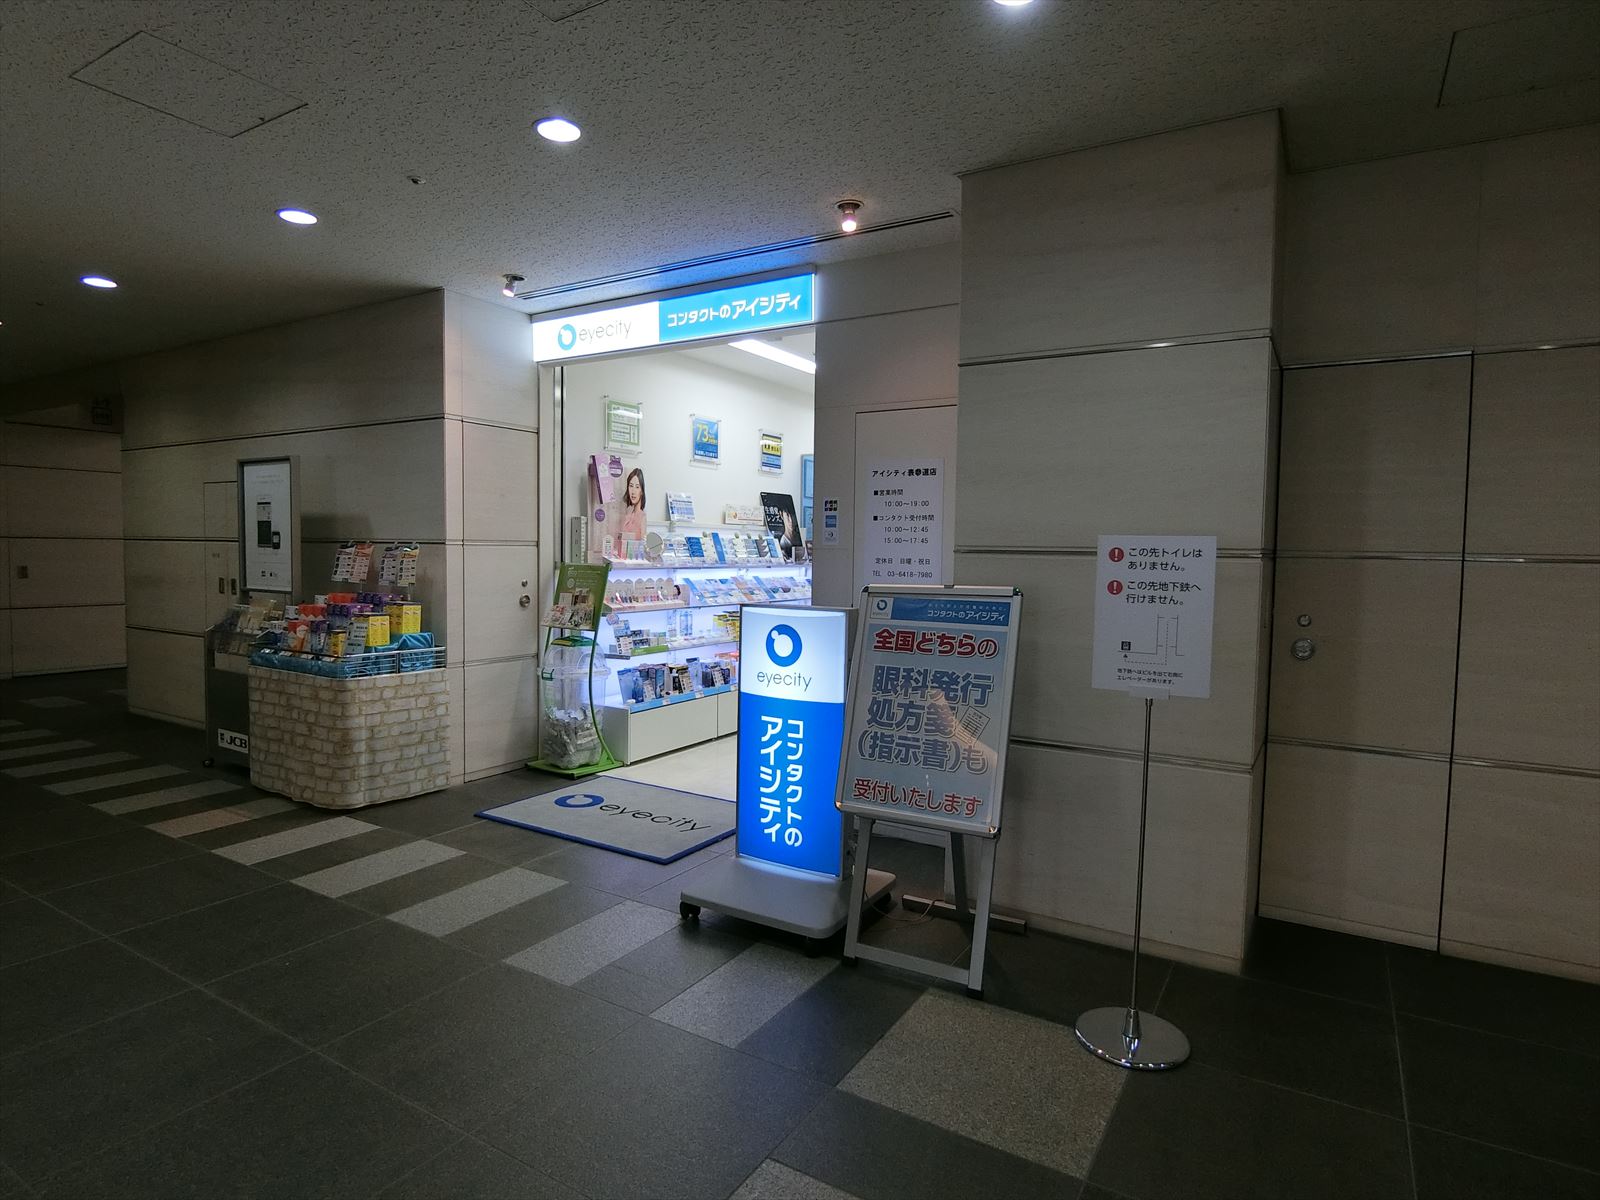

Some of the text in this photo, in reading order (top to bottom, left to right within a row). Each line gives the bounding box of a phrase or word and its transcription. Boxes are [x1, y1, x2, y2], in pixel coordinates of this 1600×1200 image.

[667, 292, 802, 328] コンタクトのアイシティ
[578, 319, 632, 343] eyecity
[871, 468, 937, 477] アイシティ表参道店
[1128, 547, 1203, 558] この先トイレは
[1127, 560, 1186, 572] ありません。
[1127, 580, 1202, 592] この先地下鉄へ
[1126, 593, 1184, 606] 行けません。
[927, 609, 1005, 621] コンタクトのアイシティ
[873, 628, 998, 657] 全国どちらの
[756, 670, 812, 692] eyecity
[872, 664, 994, 706] 眼科発行
[866, 699, 958, 738] 処方箋
[226, 735, 248, 749] JCB
[759, 715, 783, 844] アイシティ
[784, 718, 804, 848] コンタクトの
[852, 777, 984, 818] 受付いたします
[599, 802, 711, 833] eyecity
